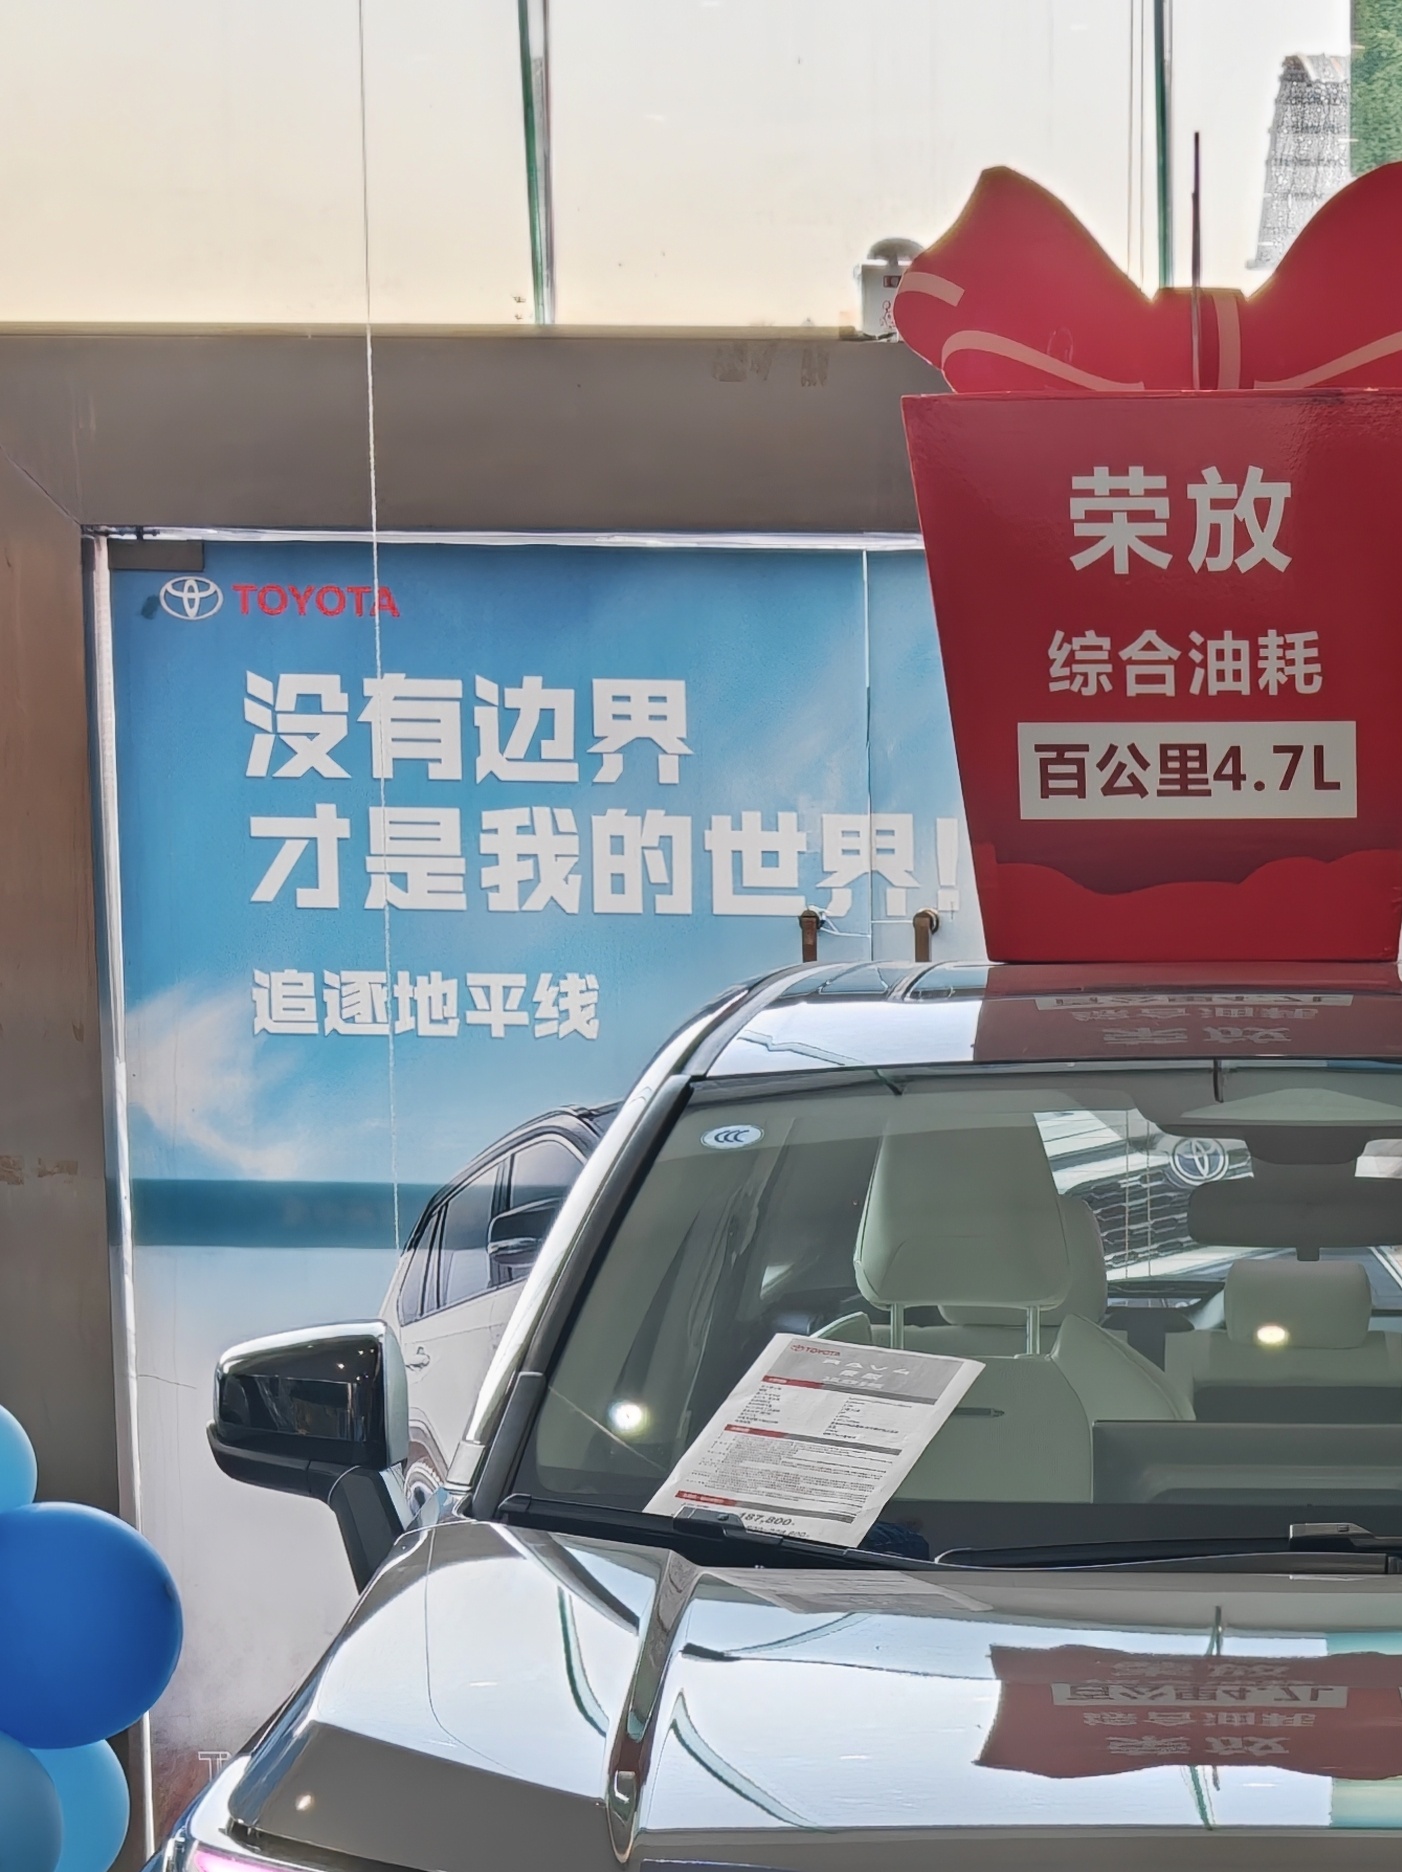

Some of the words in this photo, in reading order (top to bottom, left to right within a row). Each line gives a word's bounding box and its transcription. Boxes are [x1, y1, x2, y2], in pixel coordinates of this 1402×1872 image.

[1069, 465, 1292, 575] 荣放
[233, 584, 400, 619] TOYOTA
[1048, 629, 1324, 698] 综合油耗
[244, 670, 694, 785] 没有边界
[1033, 741, 1342, 799] 百公里4.7L
[251, 969, 600, 1039] 追逐地平线
[805, 1346, 841, 1357] TOYOTA
